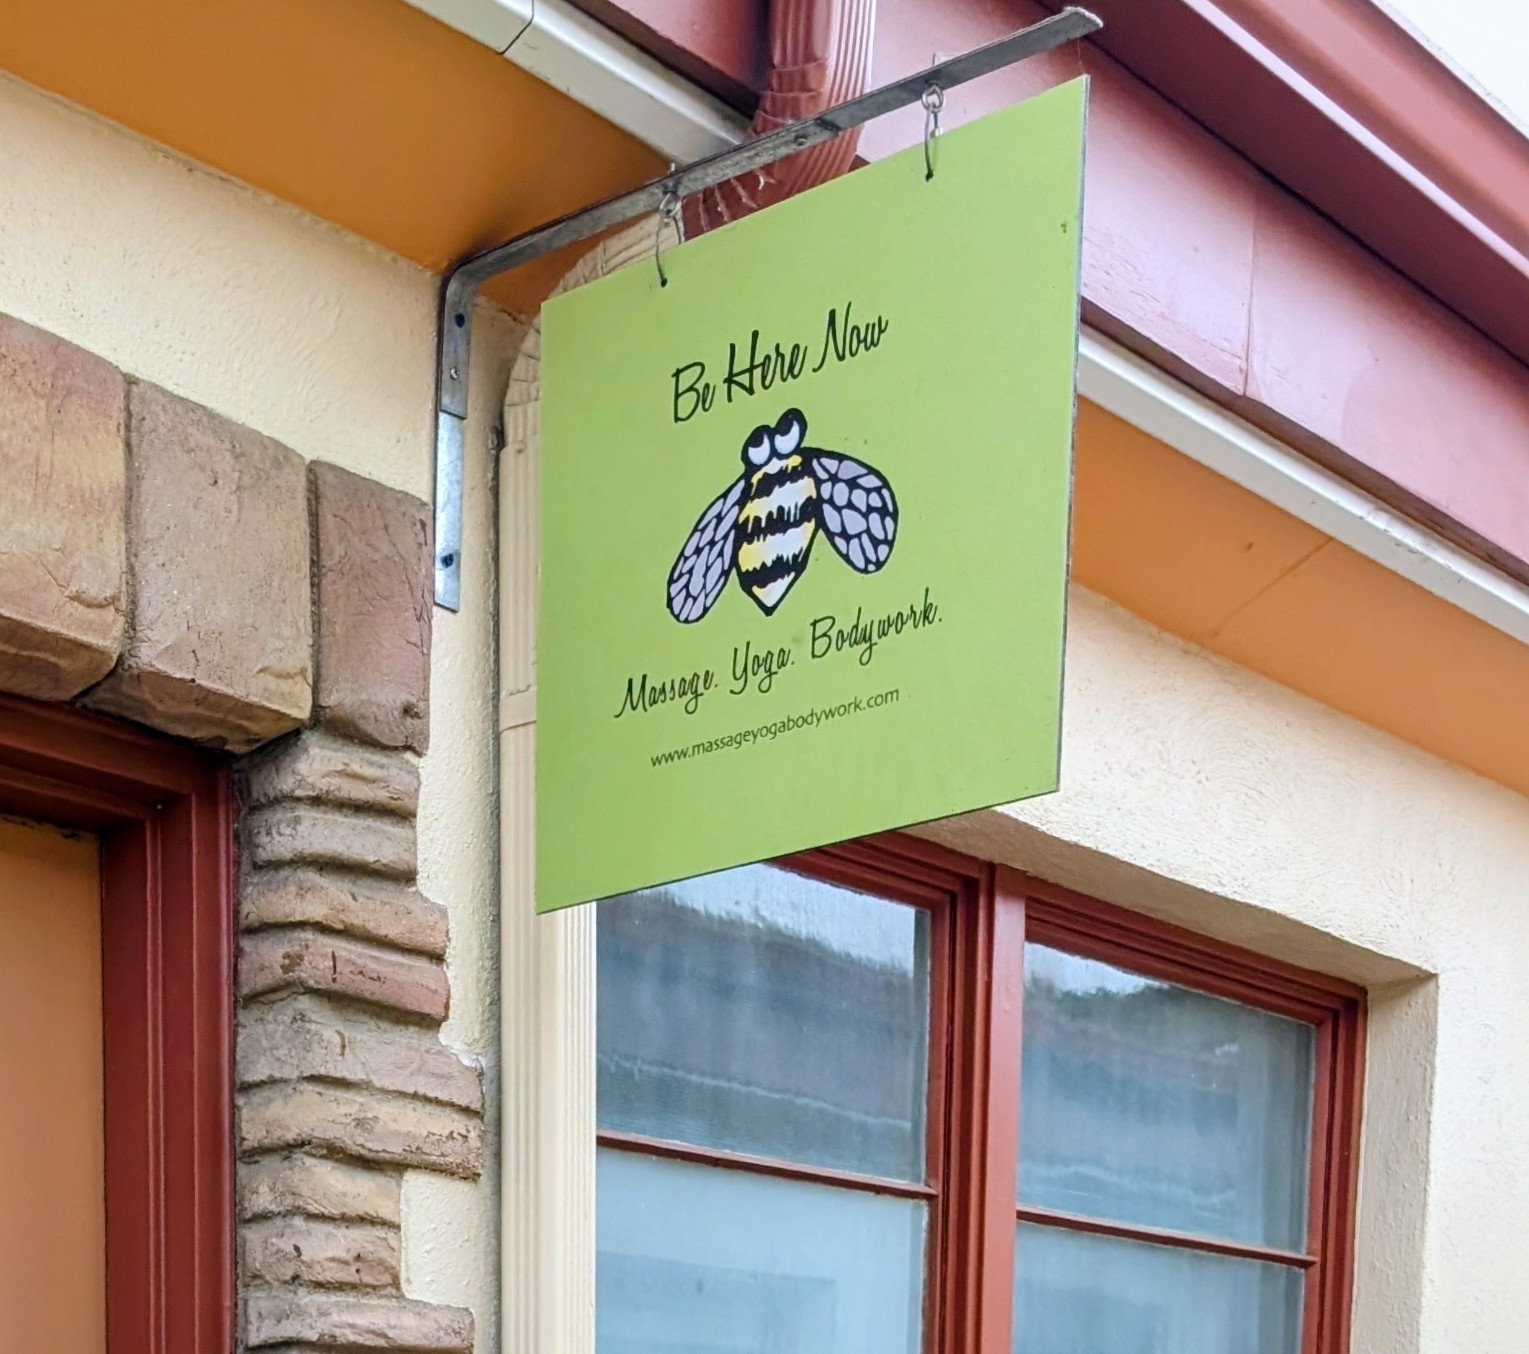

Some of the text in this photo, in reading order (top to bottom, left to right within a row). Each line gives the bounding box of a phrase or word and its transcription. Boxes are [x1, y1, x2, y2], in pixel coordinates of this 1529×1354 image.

[670, 300, 890, 424] Be Here Now
[613, 586, 944, 719] Massage. Yoga. Bodywork.
[649, 687, 900, 768] www.massageyogabodywork.com
